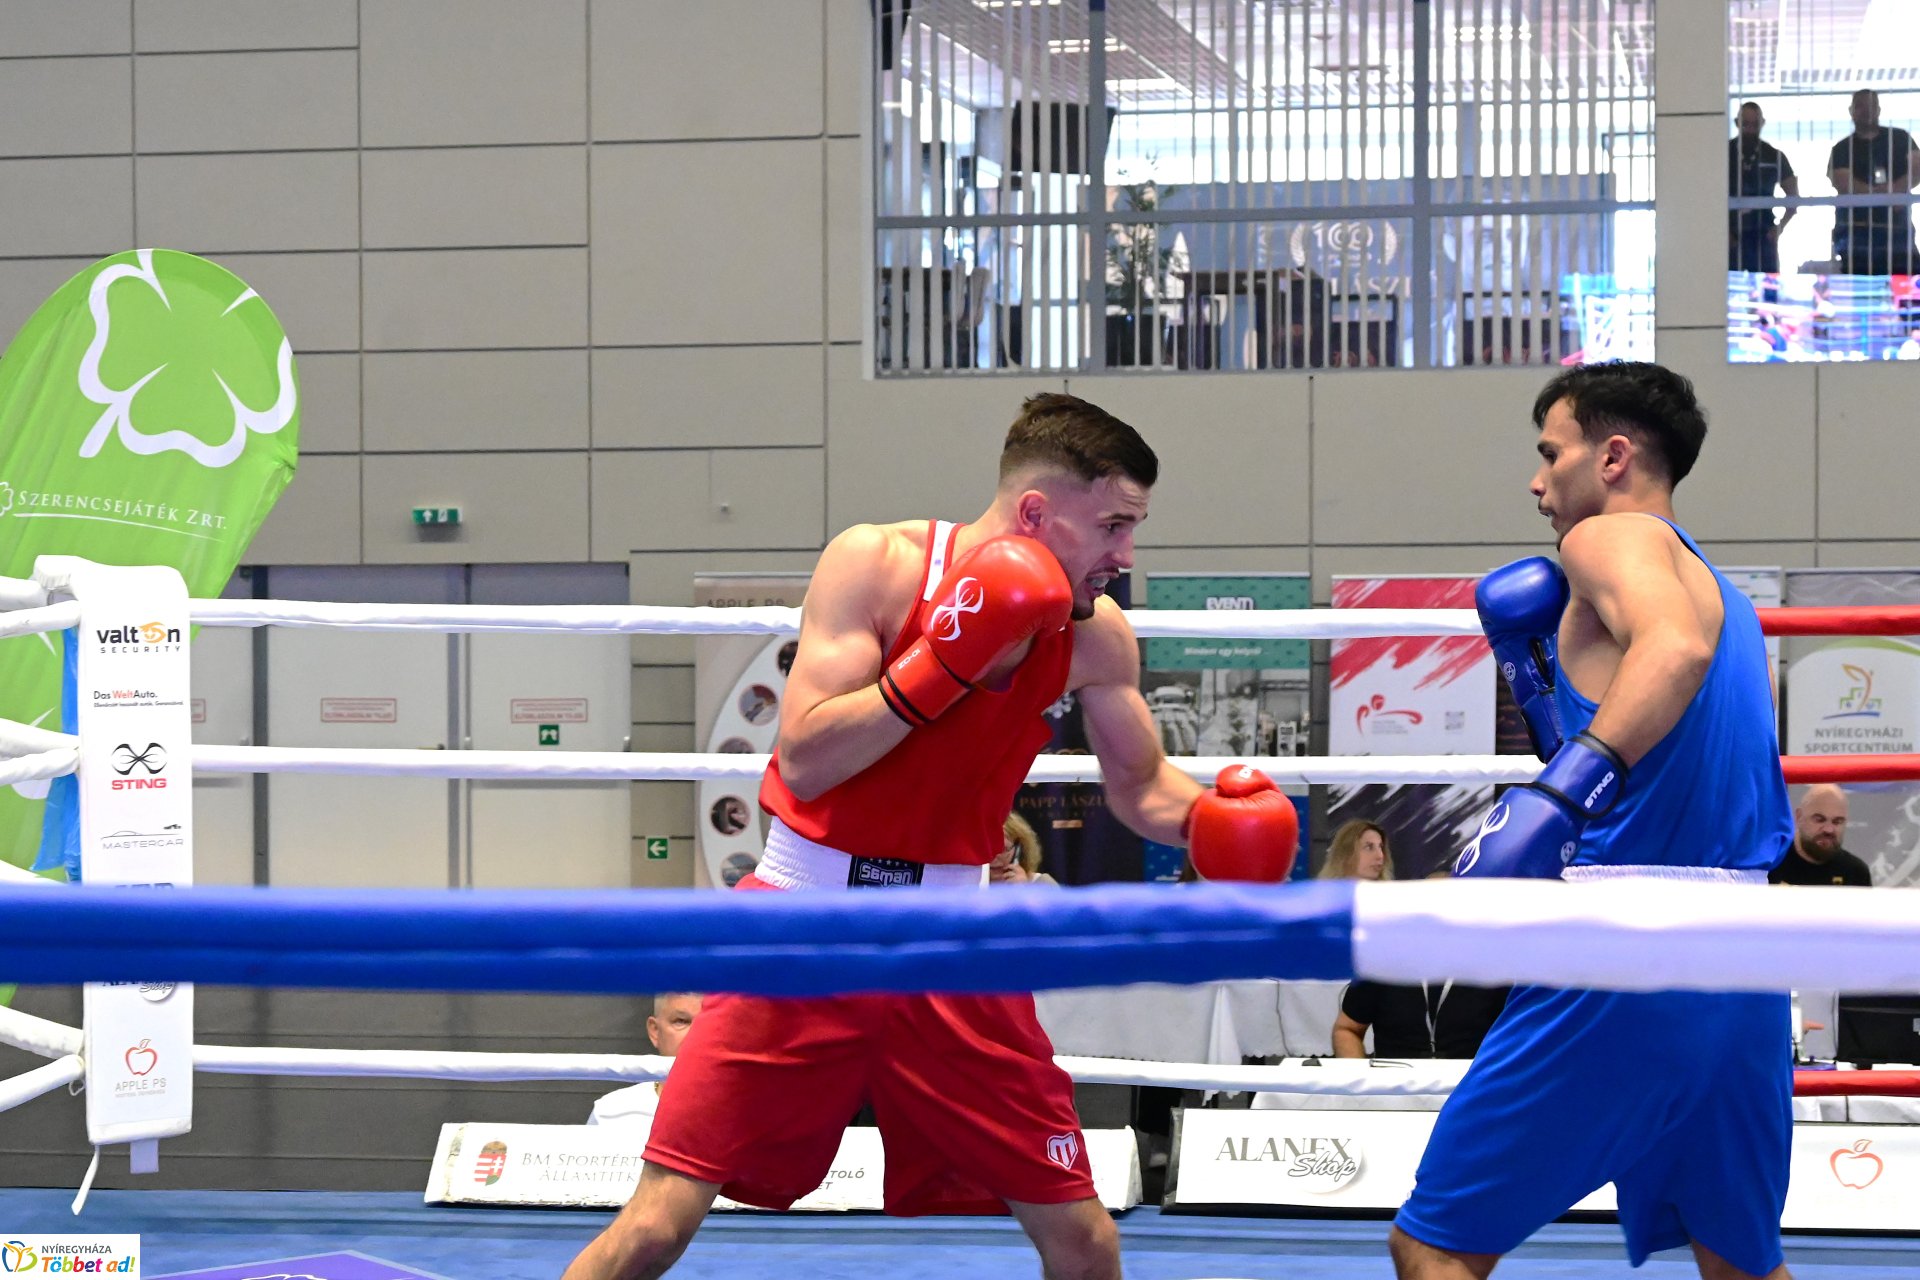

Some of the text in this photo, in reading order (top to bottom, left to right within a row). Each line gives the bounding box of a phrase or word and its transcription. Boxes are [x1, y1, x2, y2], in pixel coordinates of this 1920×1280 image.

[18, 490, 227, 529] SZERENCSEJÁTÉK ZRT.
[96, 621, 181, 644] valton
[100, 646, 181, 654] SECURITY
[93, 689, 158, 700] Das WeltAuto.
[1814, 725, 1904, 738] NYÍREGYHÁZI
[1804, 742, 1914, 753] SPORTCENTRUM
[111, 778, 167, 790] STING
[1584, 771, 1615, 809] STING
[102, 839, 184, 849] MASTERCAR
[115, 1078, 167, 1092] APPLE PS
[522, 1153, 550, 1166] BM
[1287, 1151, 1358, 1183] Shop
